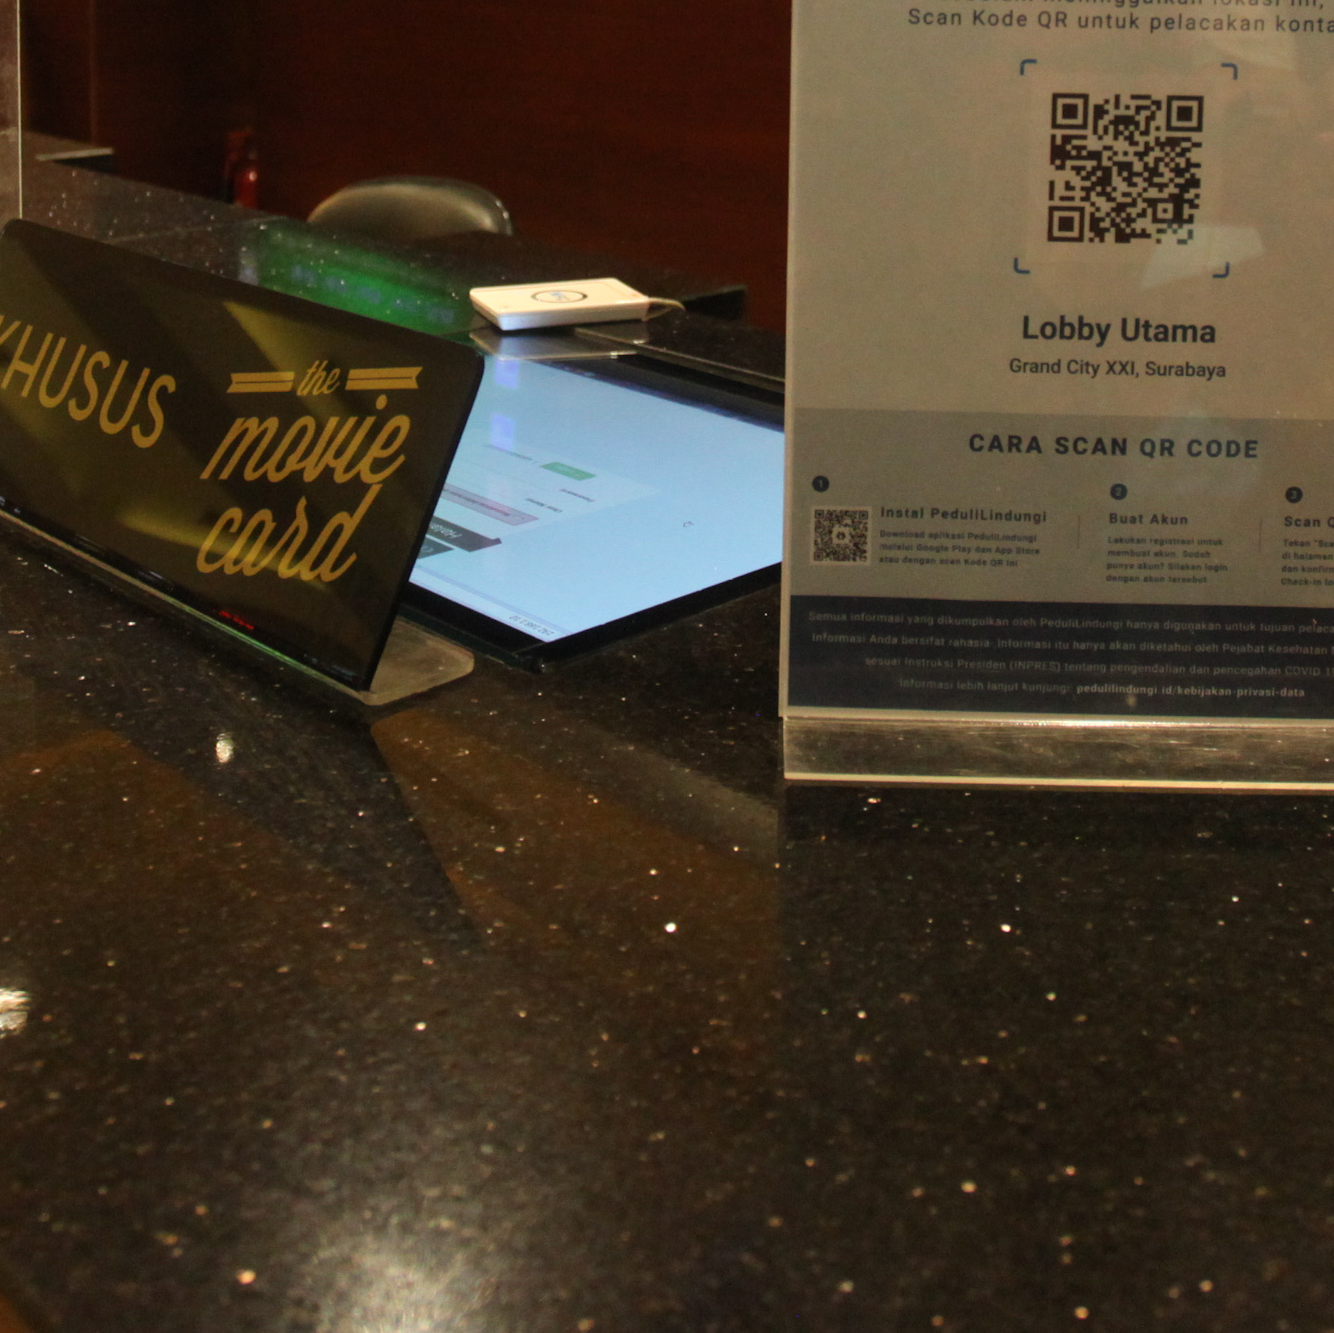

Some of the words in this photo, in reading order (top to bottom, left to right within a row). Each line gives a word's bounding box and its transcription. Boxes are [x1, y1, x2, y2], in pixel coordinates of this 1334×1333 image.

[908, 8, 961, 25] Scan
[972, 10, 1027, 27] Kode
[1038, 11, 1067, 29] QR
[1078, 13, 1140, 29] untuk
[1149, 14, 1264, 34] pelacakan
[1022, 315, 1111, 347] Lobby
[1121, 318, 1216, 343] Utama
[297, 360, 341, 397] the
[1009, 358, 1061, 374] Grand
[1066, 359, 1100, 378] City
[1106, 361, 1139, 377] XXI,
[1145, 361, 1226, 381] Surabaya
[200, 393, 411, 484] movie
[969, 434, 1042, 454] CARA
[1055, 437, 1127, 455] SCAN
[1140, 438, 1175, 458] QR
[1187, 439, 1258, 458] CODE
[881, 507, 924, 518] Instal
[931, 508, 1046, 524] PeduliLindungi
[1109, 513, 1143, 524] Buat
[1149, 514, 1188, 525] Akun
[1284, 516, 1321, 527] Scan
[196, 483, 382, 583] card
